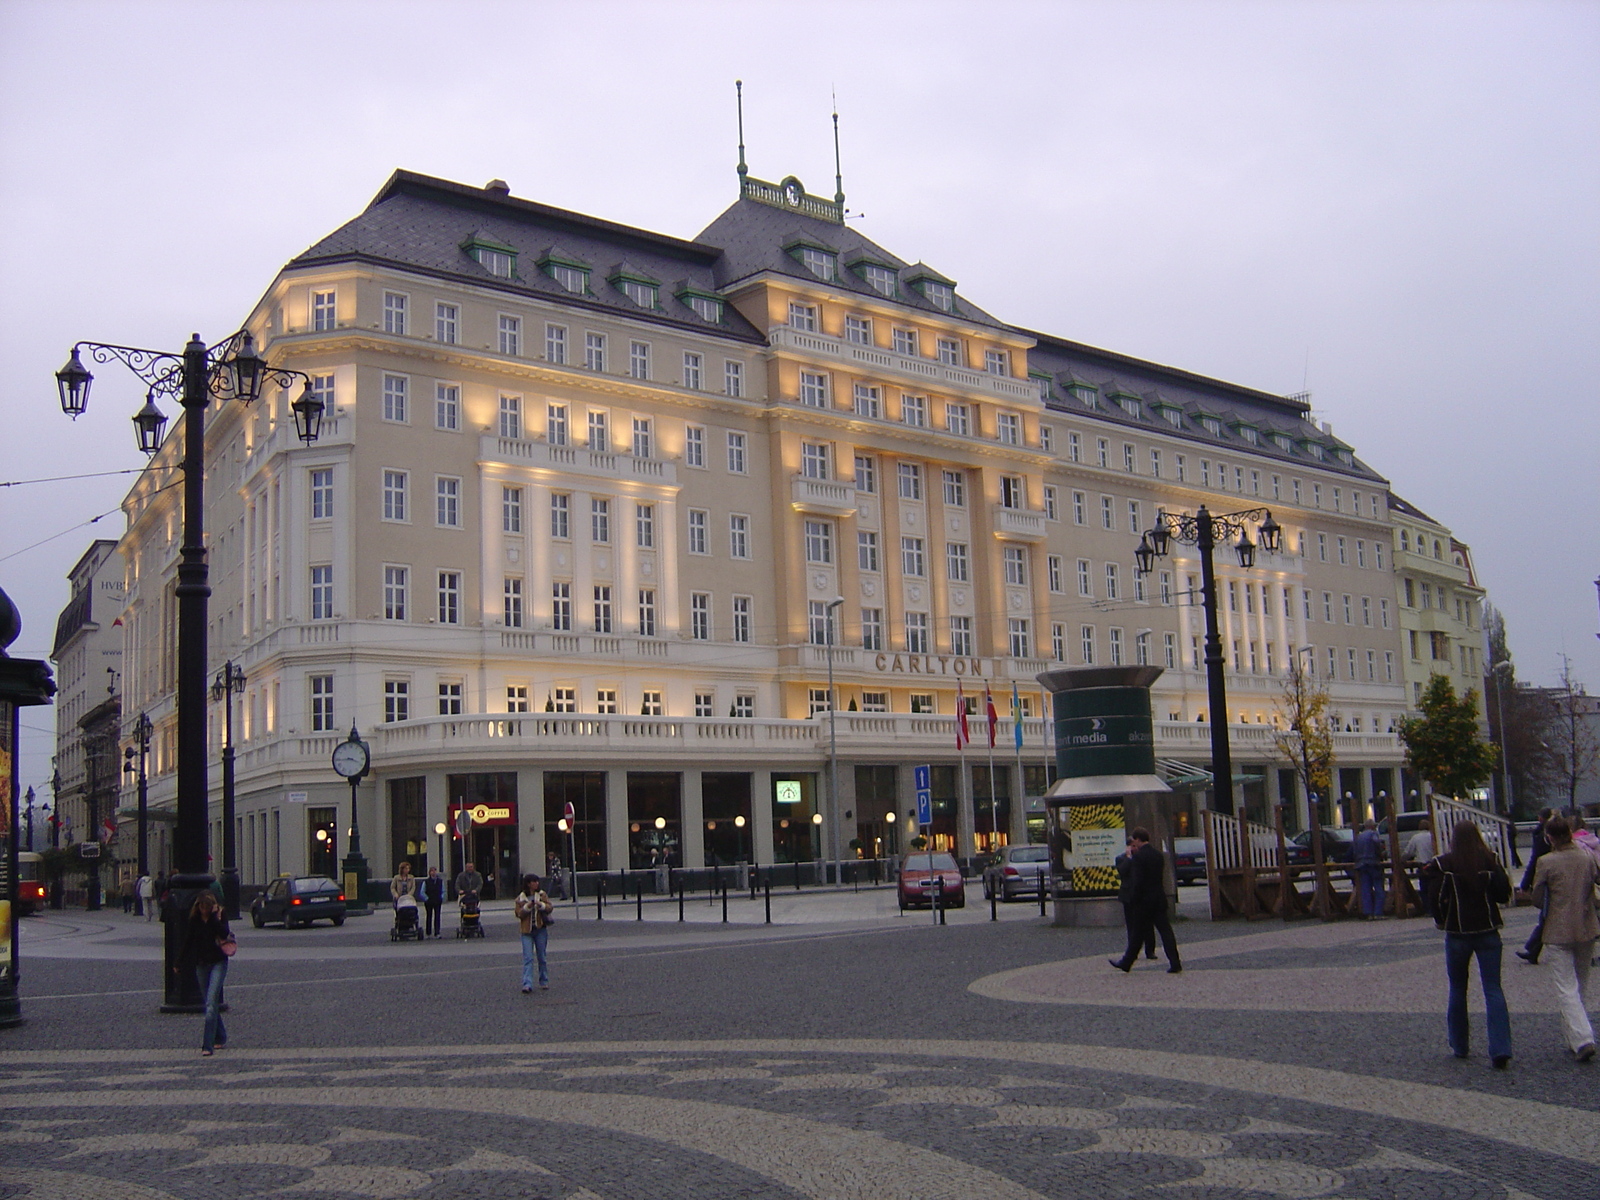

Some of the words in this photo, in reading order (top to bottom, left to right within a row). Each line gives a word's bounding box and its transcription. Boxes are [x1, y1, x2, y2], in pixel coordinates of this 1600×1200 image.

[101, 581, 123, 590] HVB
[875, 653, 982, 676] CARLTON
[1072, 731, 1107, 744] media
[920, 795, 927, 813] P
